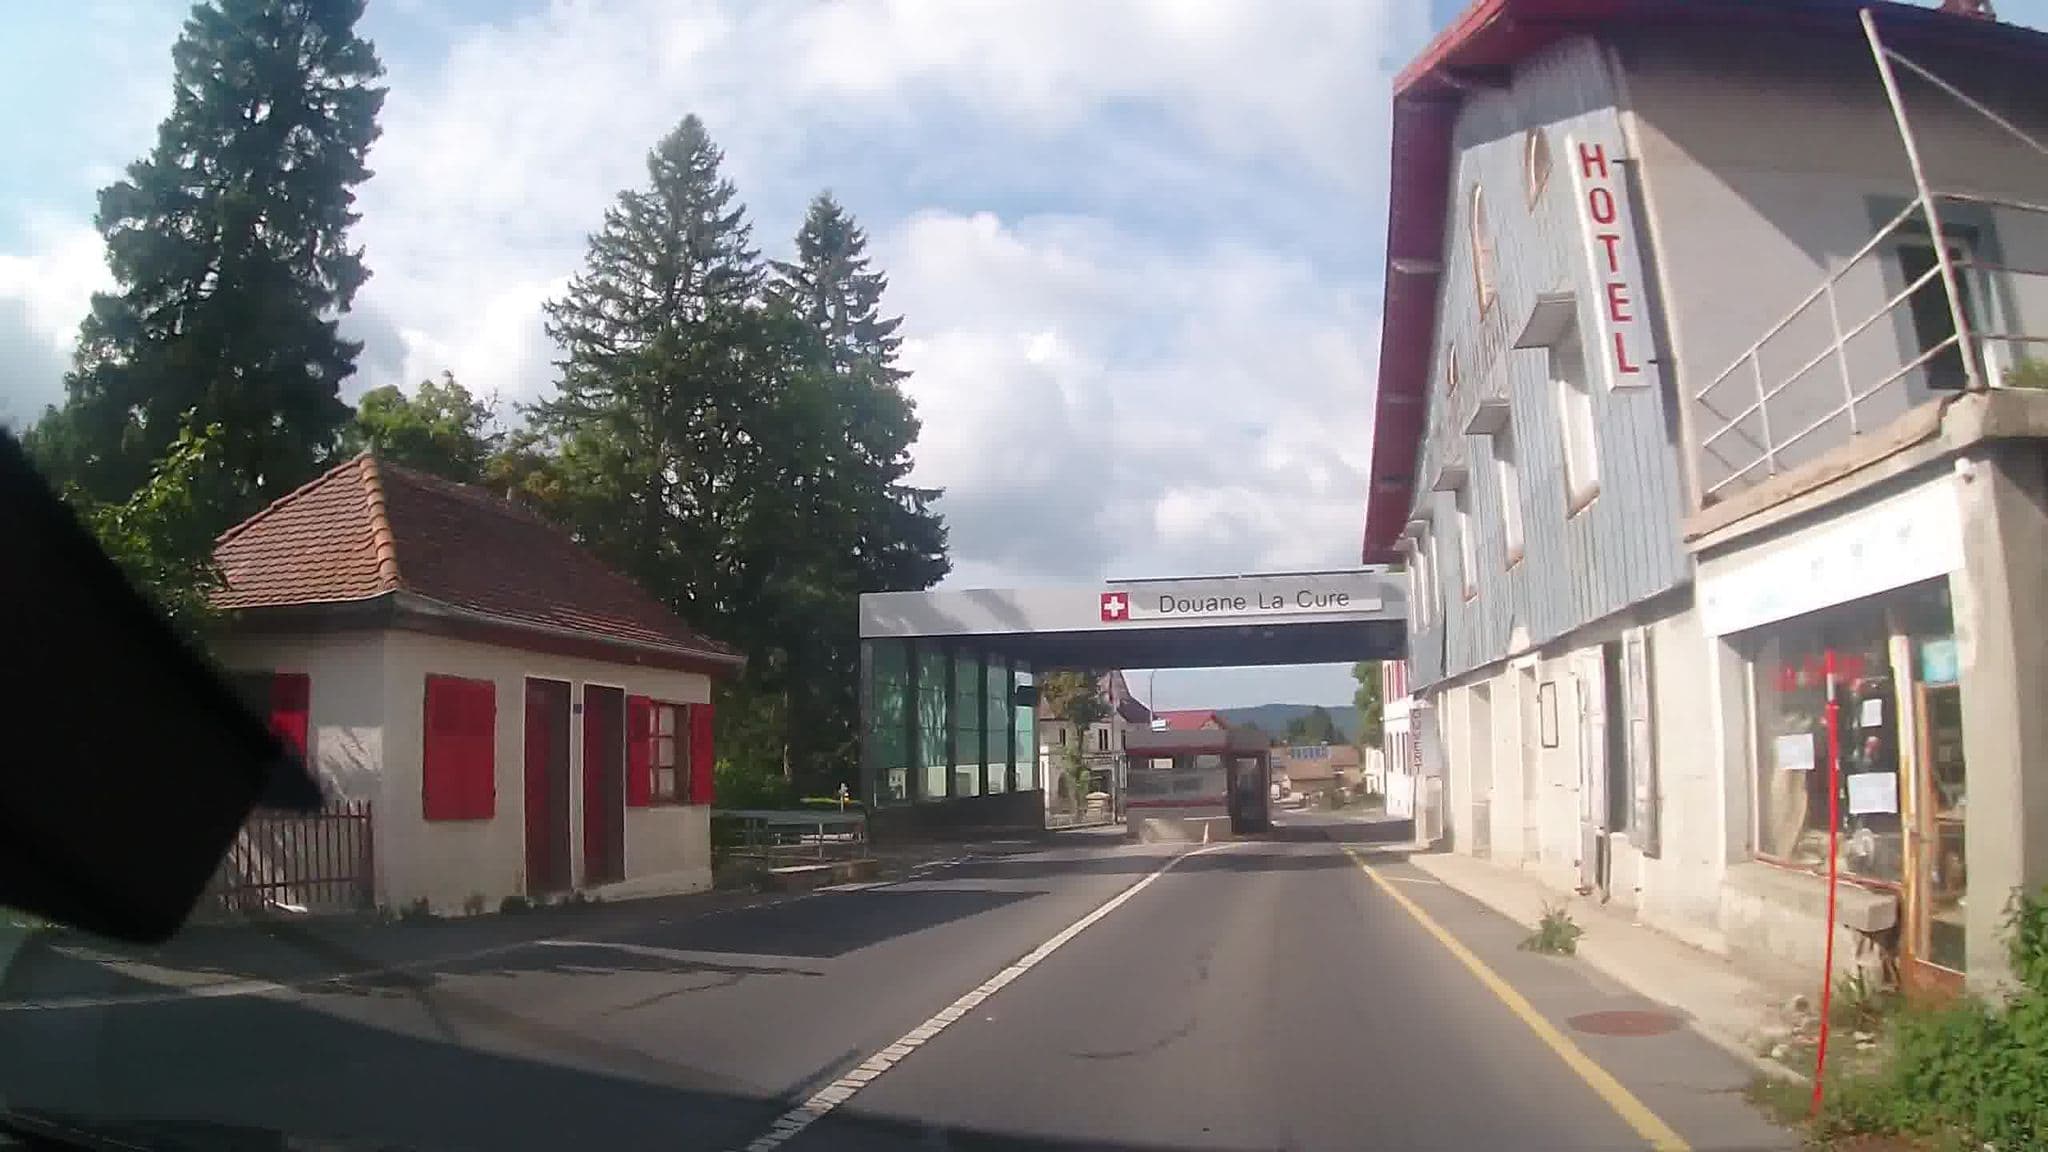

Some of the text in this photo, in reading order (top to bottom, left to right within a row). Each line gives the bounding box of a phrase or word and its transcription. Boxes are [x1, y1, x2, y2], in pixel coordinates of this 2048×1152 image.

[1579, 142, 1640, 373] HOTEL
[1159, 589, 1350, 613] Douane La Cure
